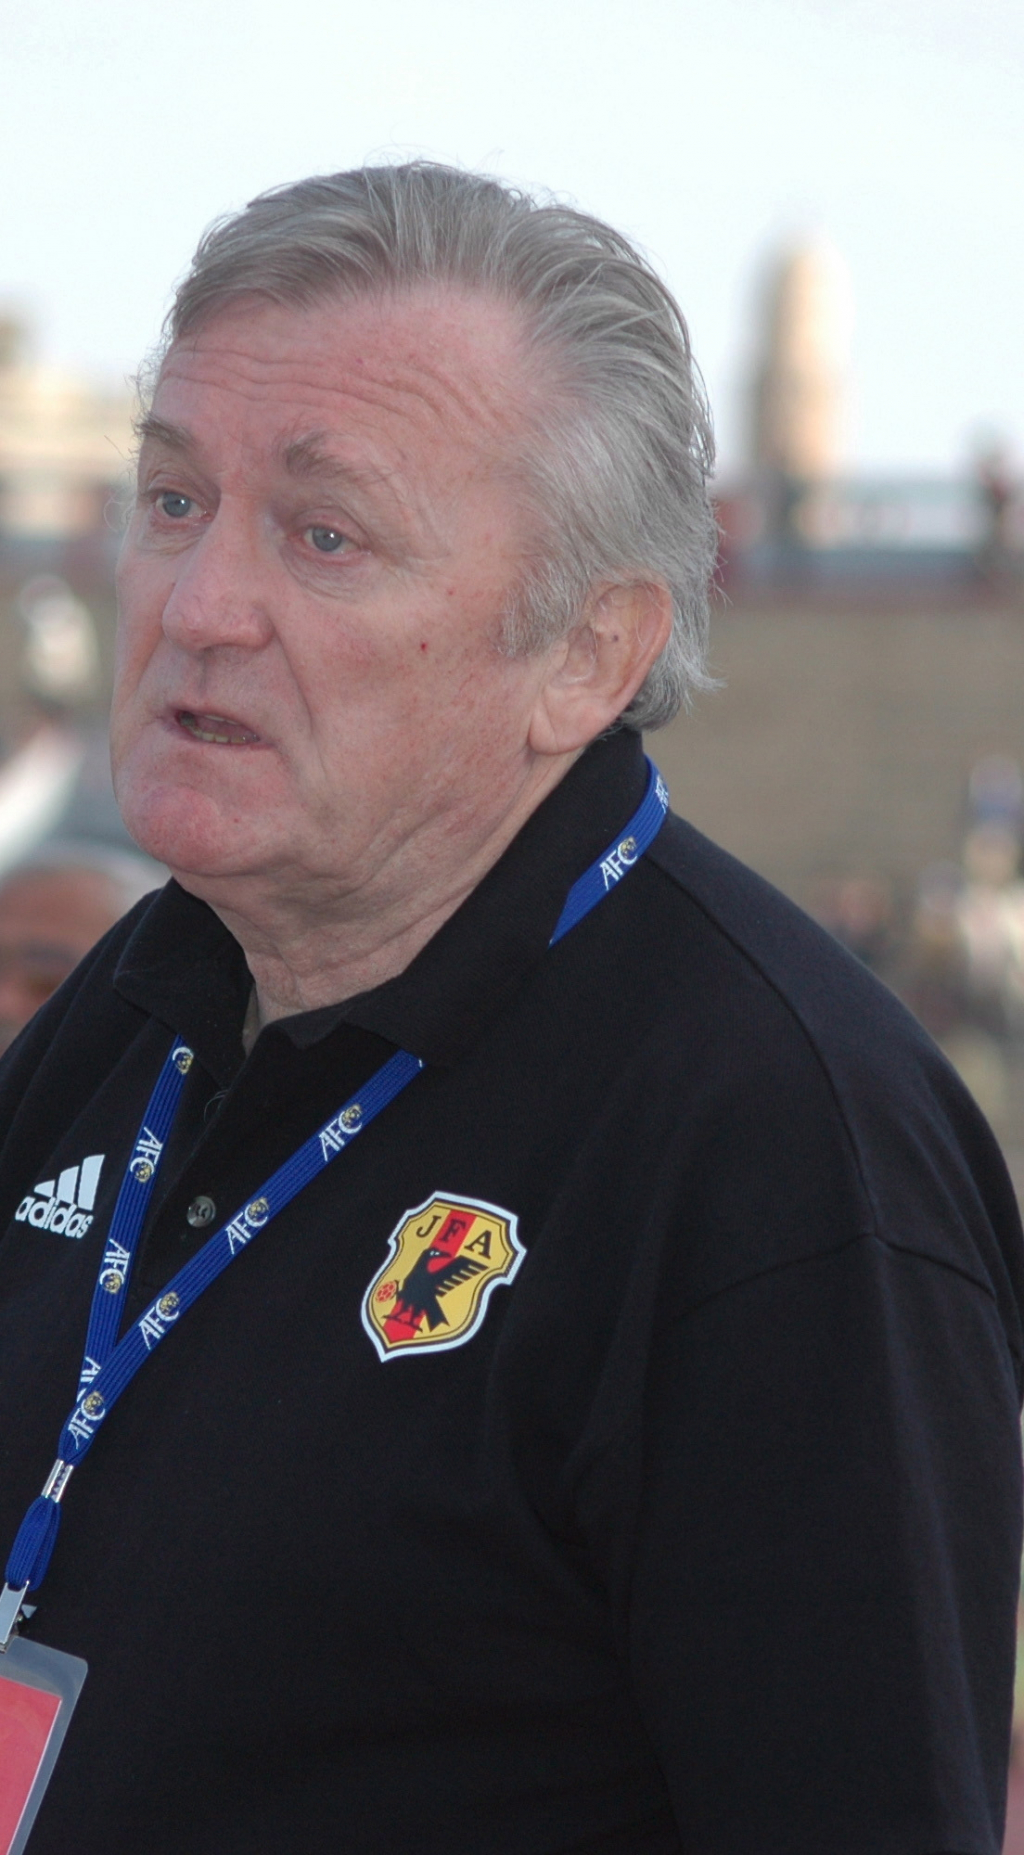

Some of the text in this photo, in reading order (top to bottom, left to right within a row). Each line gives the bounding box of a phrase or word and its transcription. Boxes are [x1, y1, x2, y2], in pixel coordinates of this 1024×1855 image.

[600, 840, 638, 891] AFC
[130, 1127, 163, 1176] AFC
[319, 1110, 363, 1161] AFC
[15, 1196, 94, 1239] adidas
[226, 1203, 269, 1254] AFC
[99, 1238, 131, 1285] AFC
[138, 1298, 179, 1351] AFC
[67, 1398, 106, 1451] AFC
